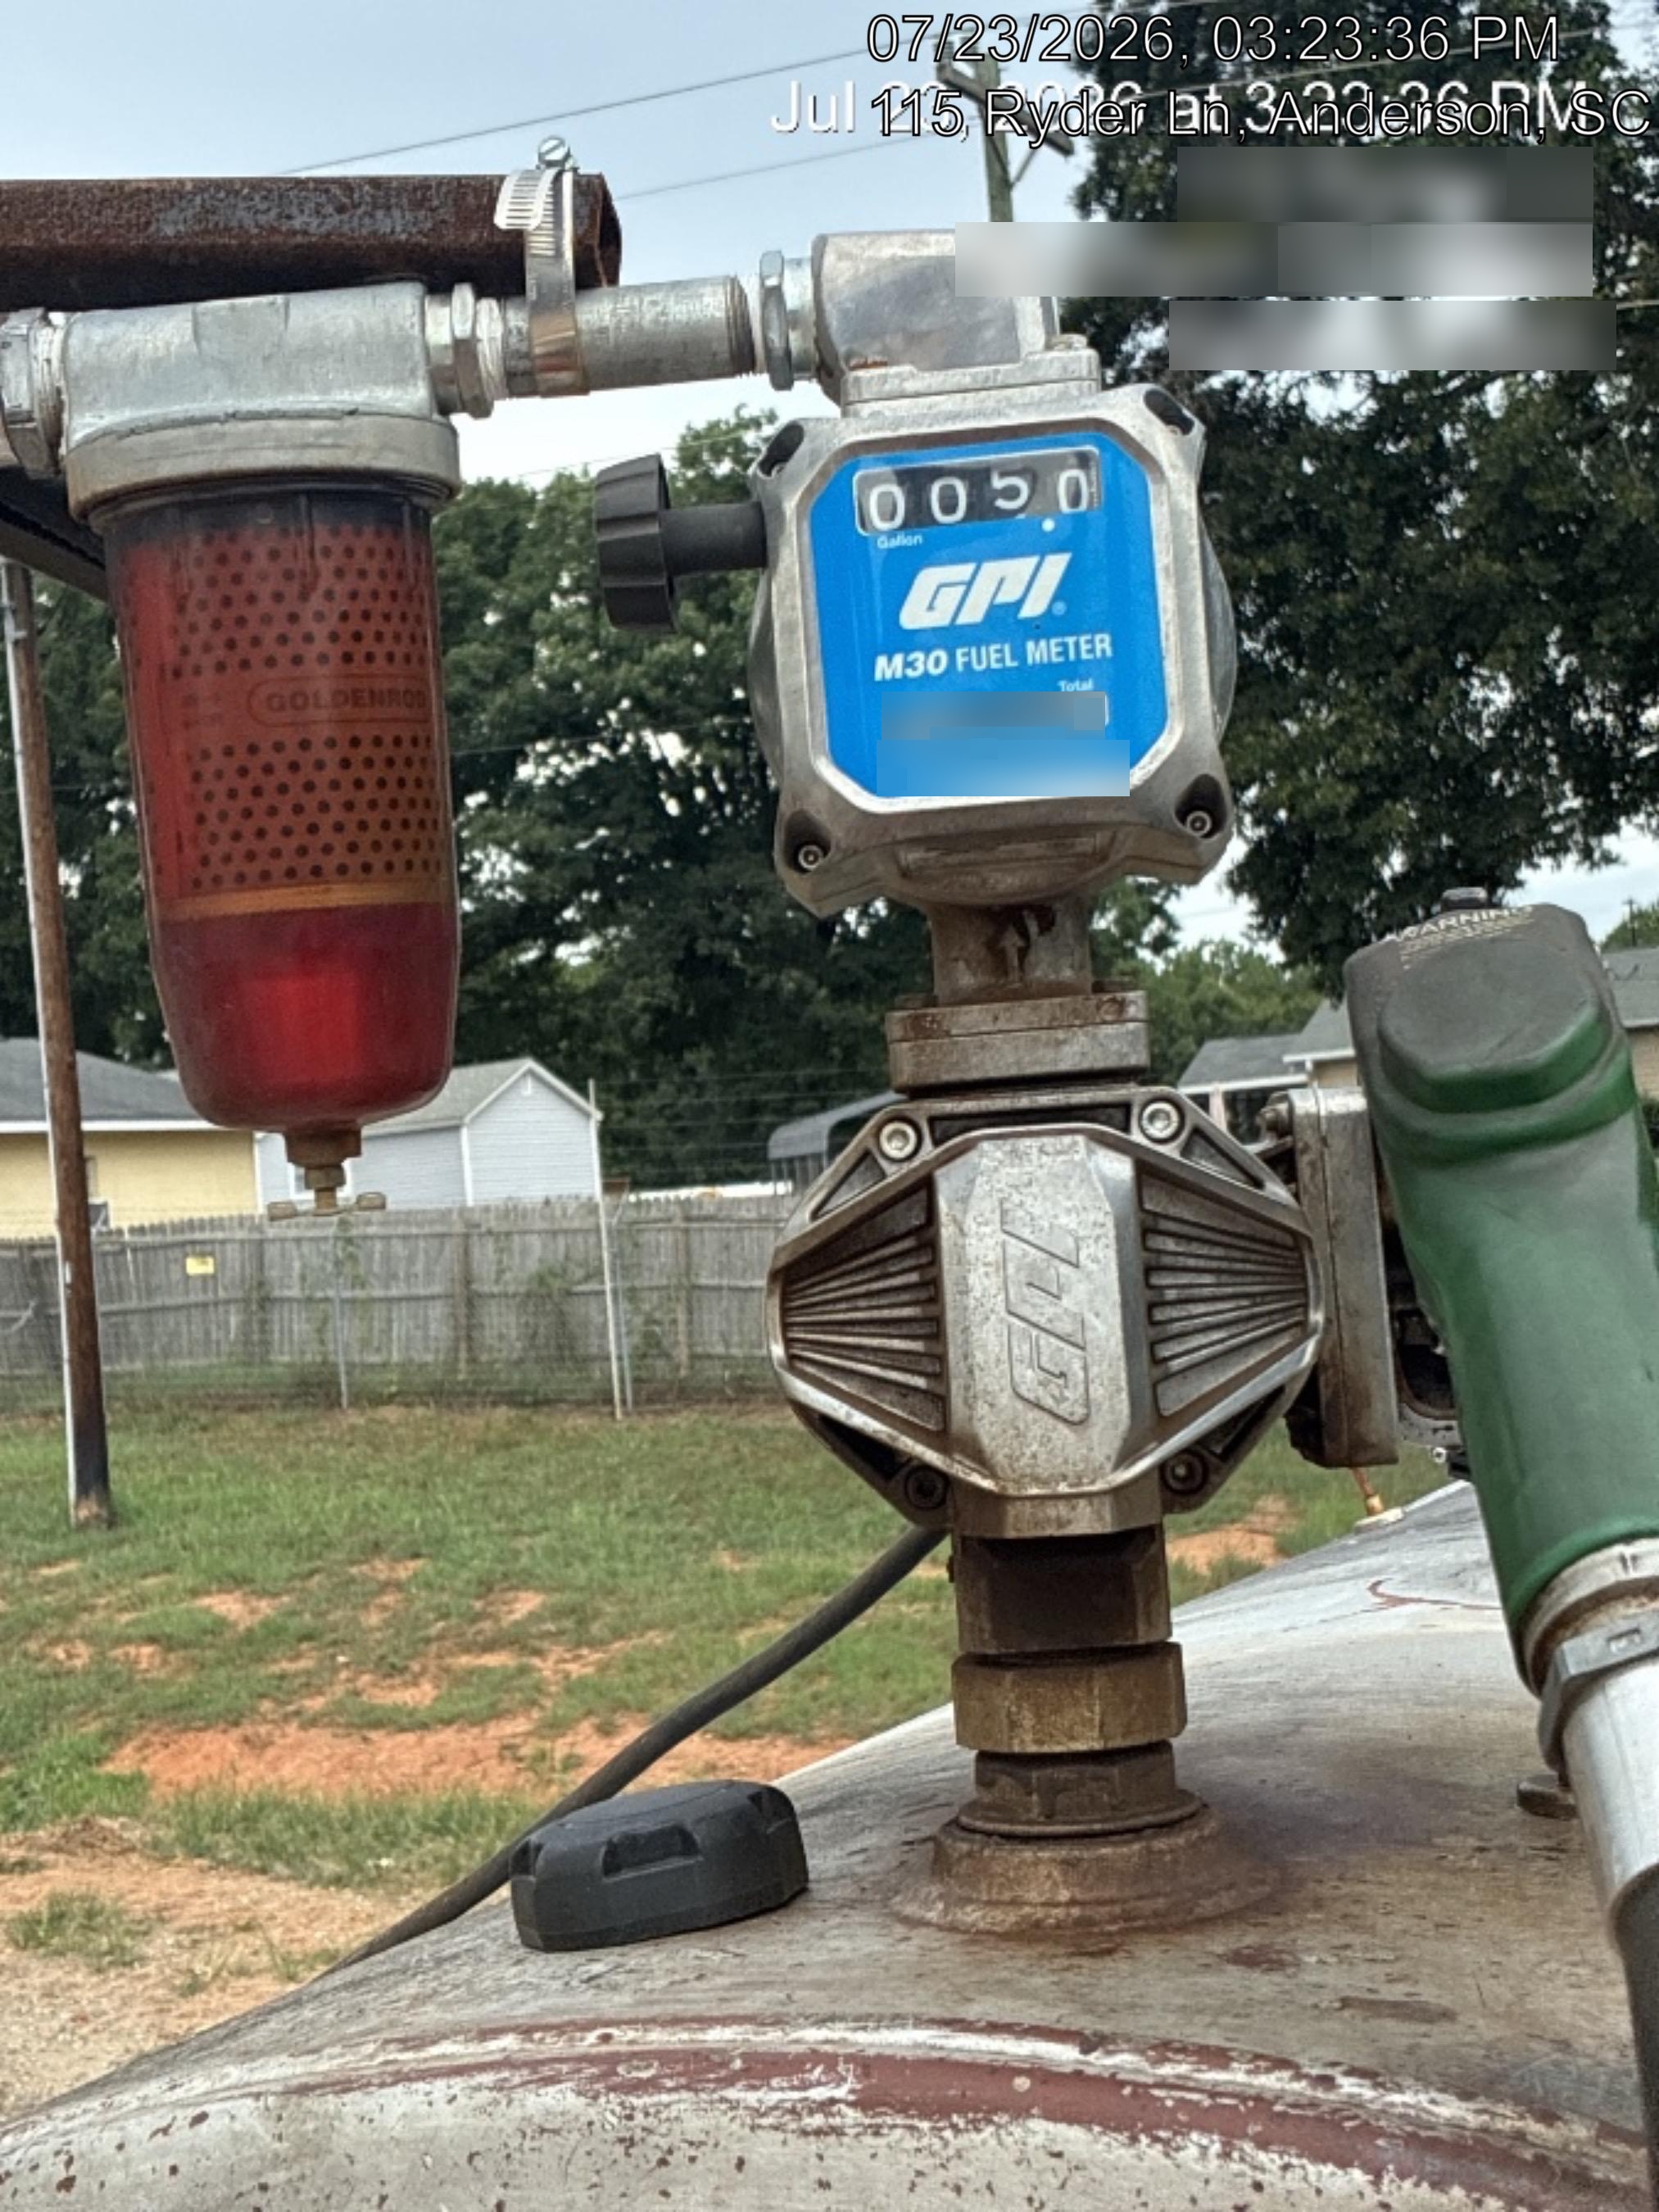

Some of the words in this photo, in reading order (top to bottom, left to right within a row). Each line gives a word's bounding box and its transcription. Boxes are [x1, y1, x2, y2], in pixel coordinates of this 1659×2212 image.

[877, 532, 923, 550] Gallon
[873, 650, 949, 682] M30
[955, 643, 1018, 673] FUEL
[1027, 633, 1113, 666] METER
[1057, 678, 1094, 692] Total
